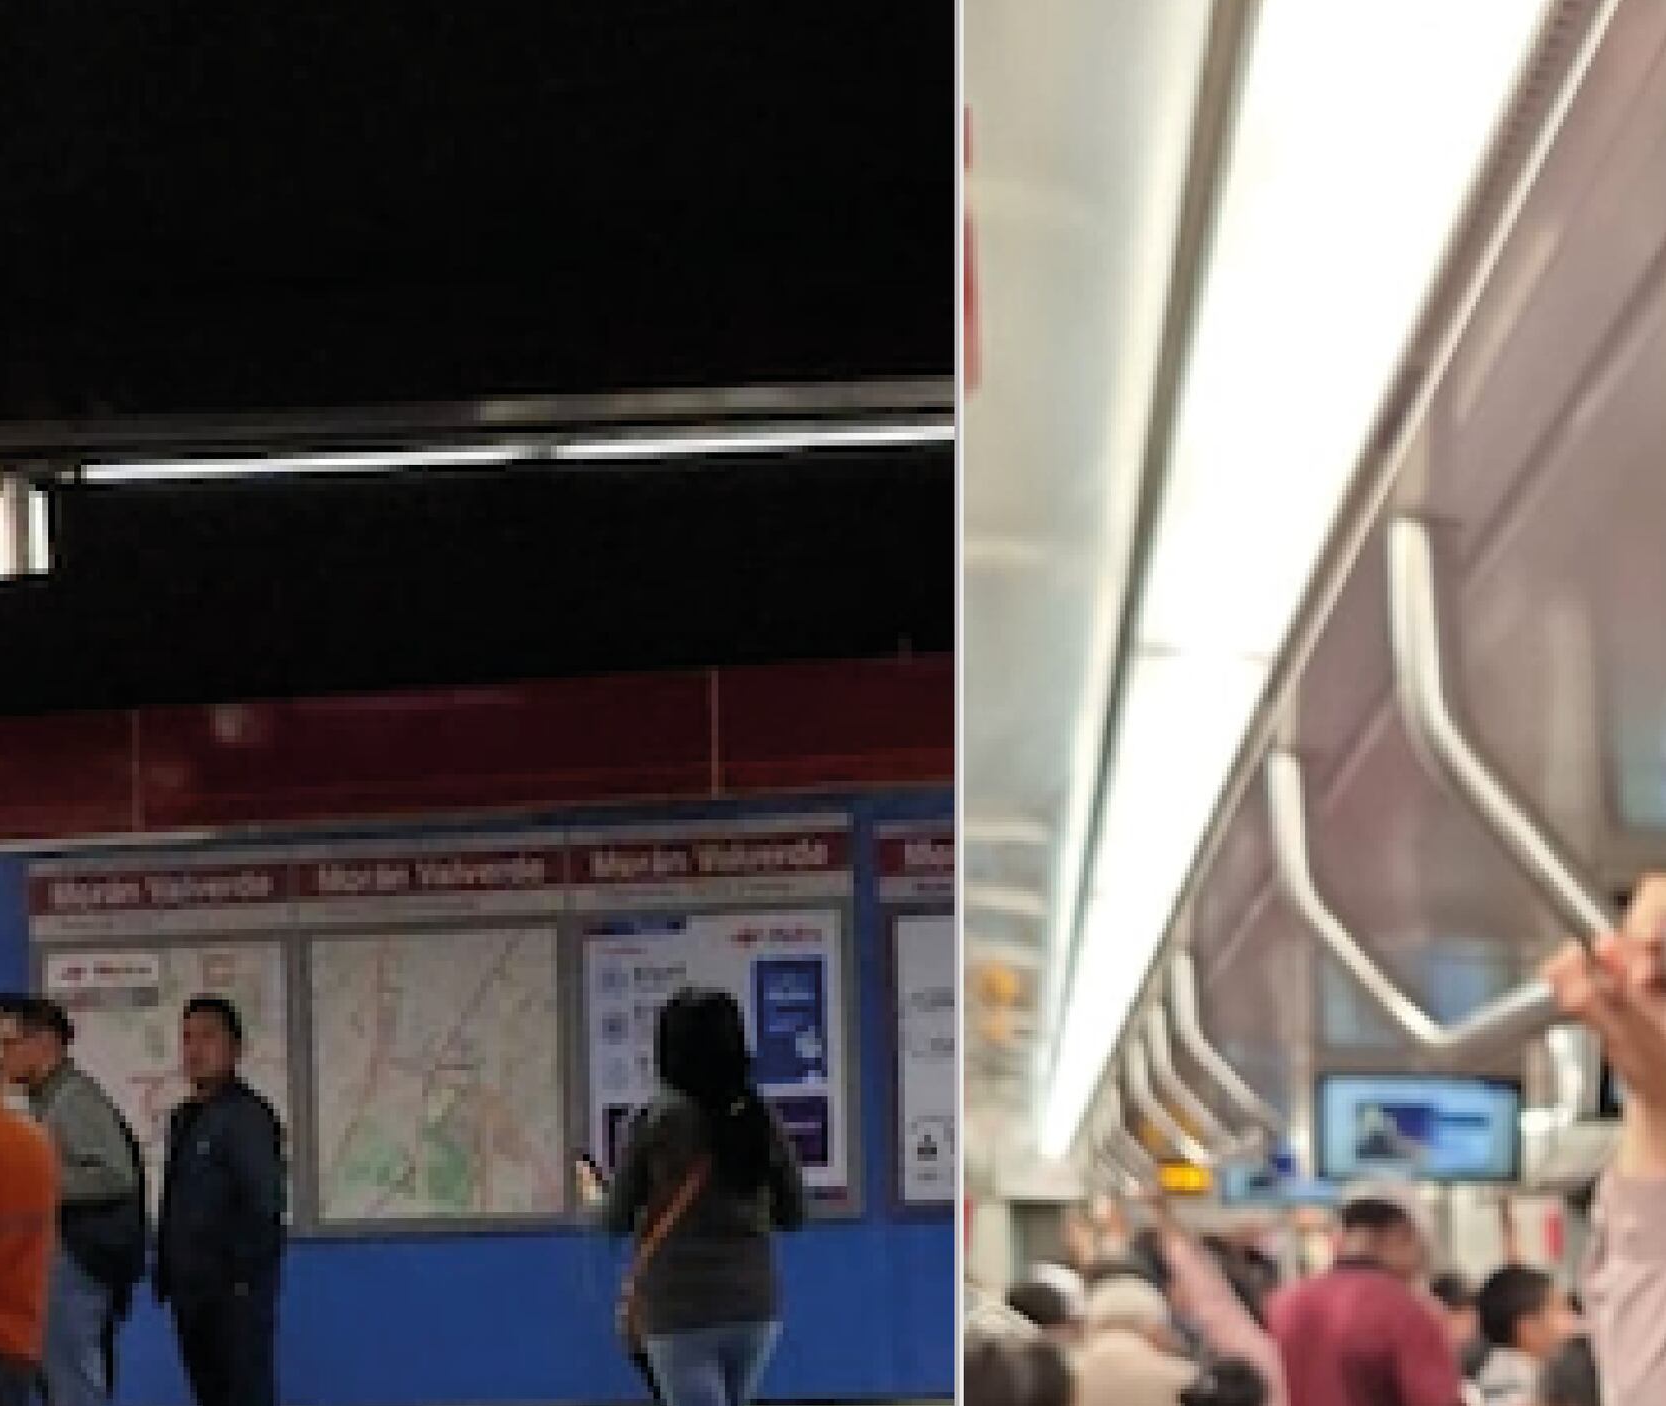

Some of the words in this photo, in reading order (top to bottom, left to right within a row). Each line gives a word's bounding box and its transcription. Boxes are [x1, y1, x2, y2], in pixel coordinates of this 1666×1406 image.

[693, 838, 829, 867] Valverde
[415, 857, 545, 885] Valverde
[145, 871, 274, 901] Valverde
